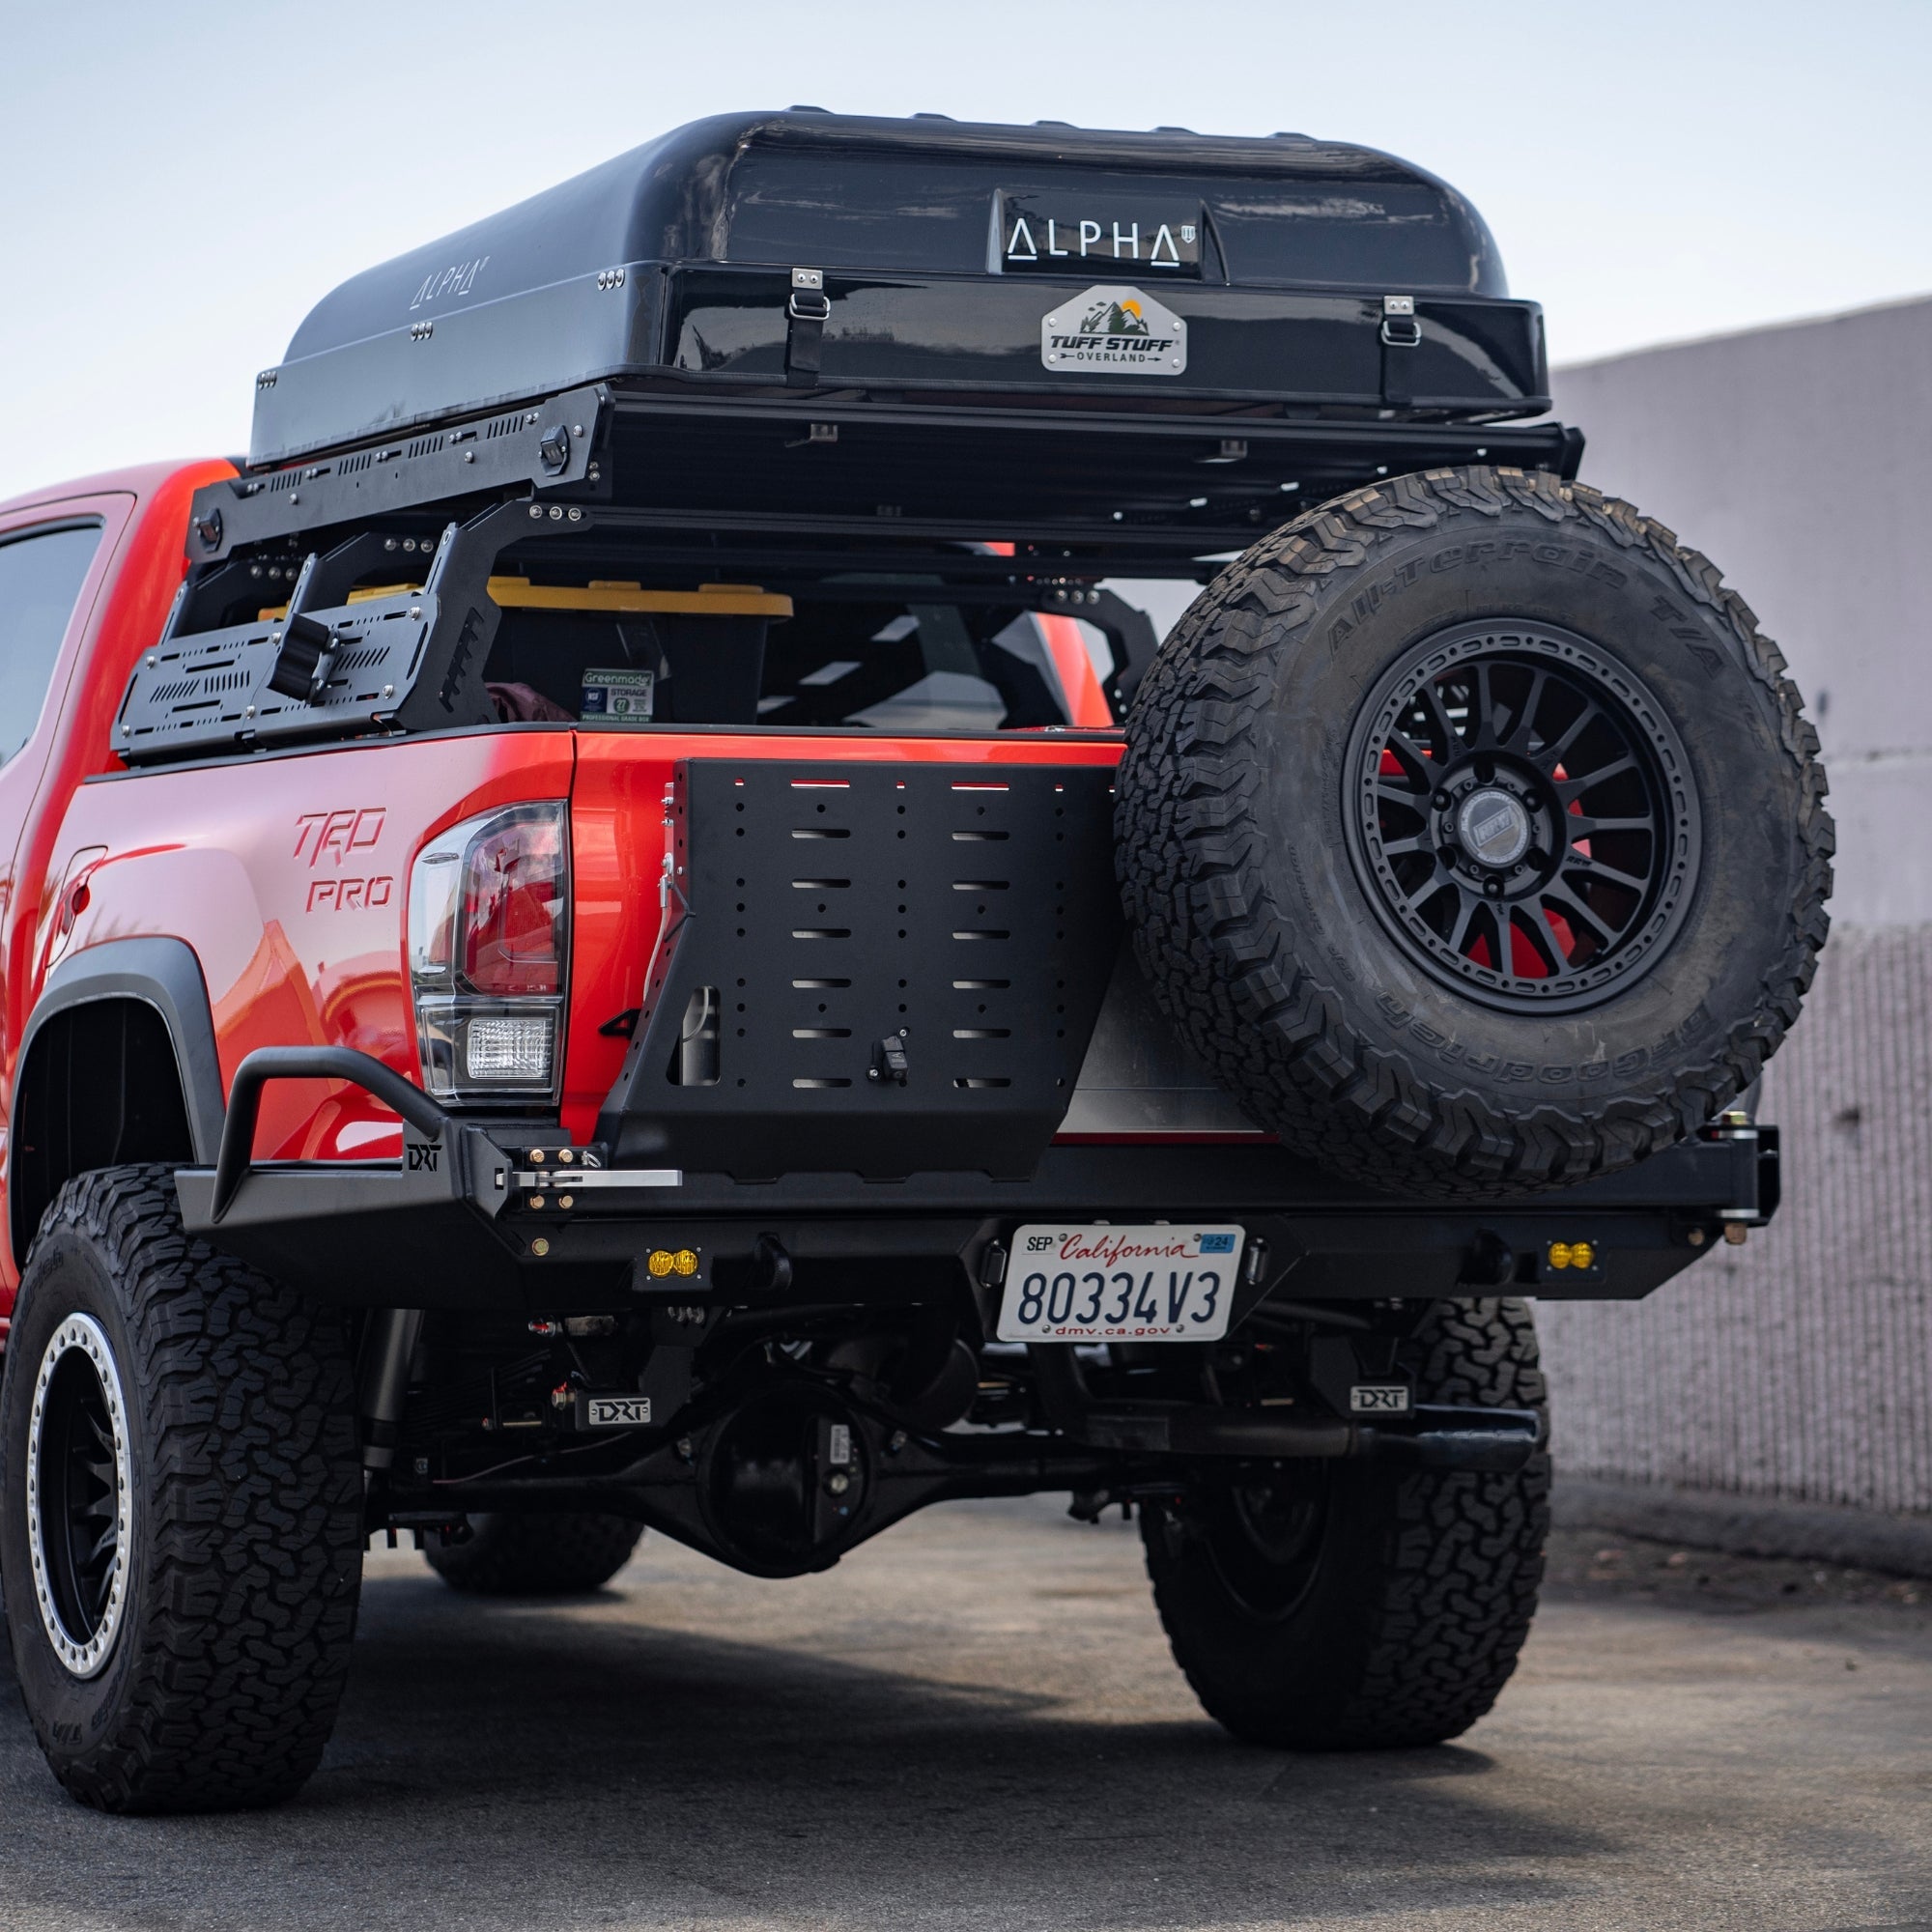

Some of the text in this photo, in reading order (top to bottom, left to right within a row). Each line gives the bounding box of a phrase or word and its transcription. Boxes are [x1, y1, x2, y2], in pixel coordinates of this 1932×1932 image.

[1008, 217, 1180, 267] ALPHA
[410, 258, 481, 311] ALPHA
[1050, 334, 1175, 353] TUFF STUFF
[1076, 352, 1146, 363] OVERLAND
[1648, 593, 1725, 675] T/A
[584, 671, 649, 686] Greenmade
[611, 688, 647, 696] STORAGE
[617, 699, 626, 708] 27
[293, 807, 387, 868] TRD
[305, 875, 394, 913] PRO
[1376, 991, 1713, 1084] BFGoodrich
[406, 1143, 442, 1173] DRT
[1026, 1236, 1053, 1251] SEP
[1059, 1234, 1199, 1268] California
[1214, 1236, 1229, 1247] 24
[1017, 1270, 1221, 1325] 80334V3
[1055, 1326, 1171, 1337] dmv.ca.gov
[594, 1399, 649, 1423] DRT
[1356, 1388, 1406, 1408] DRT
